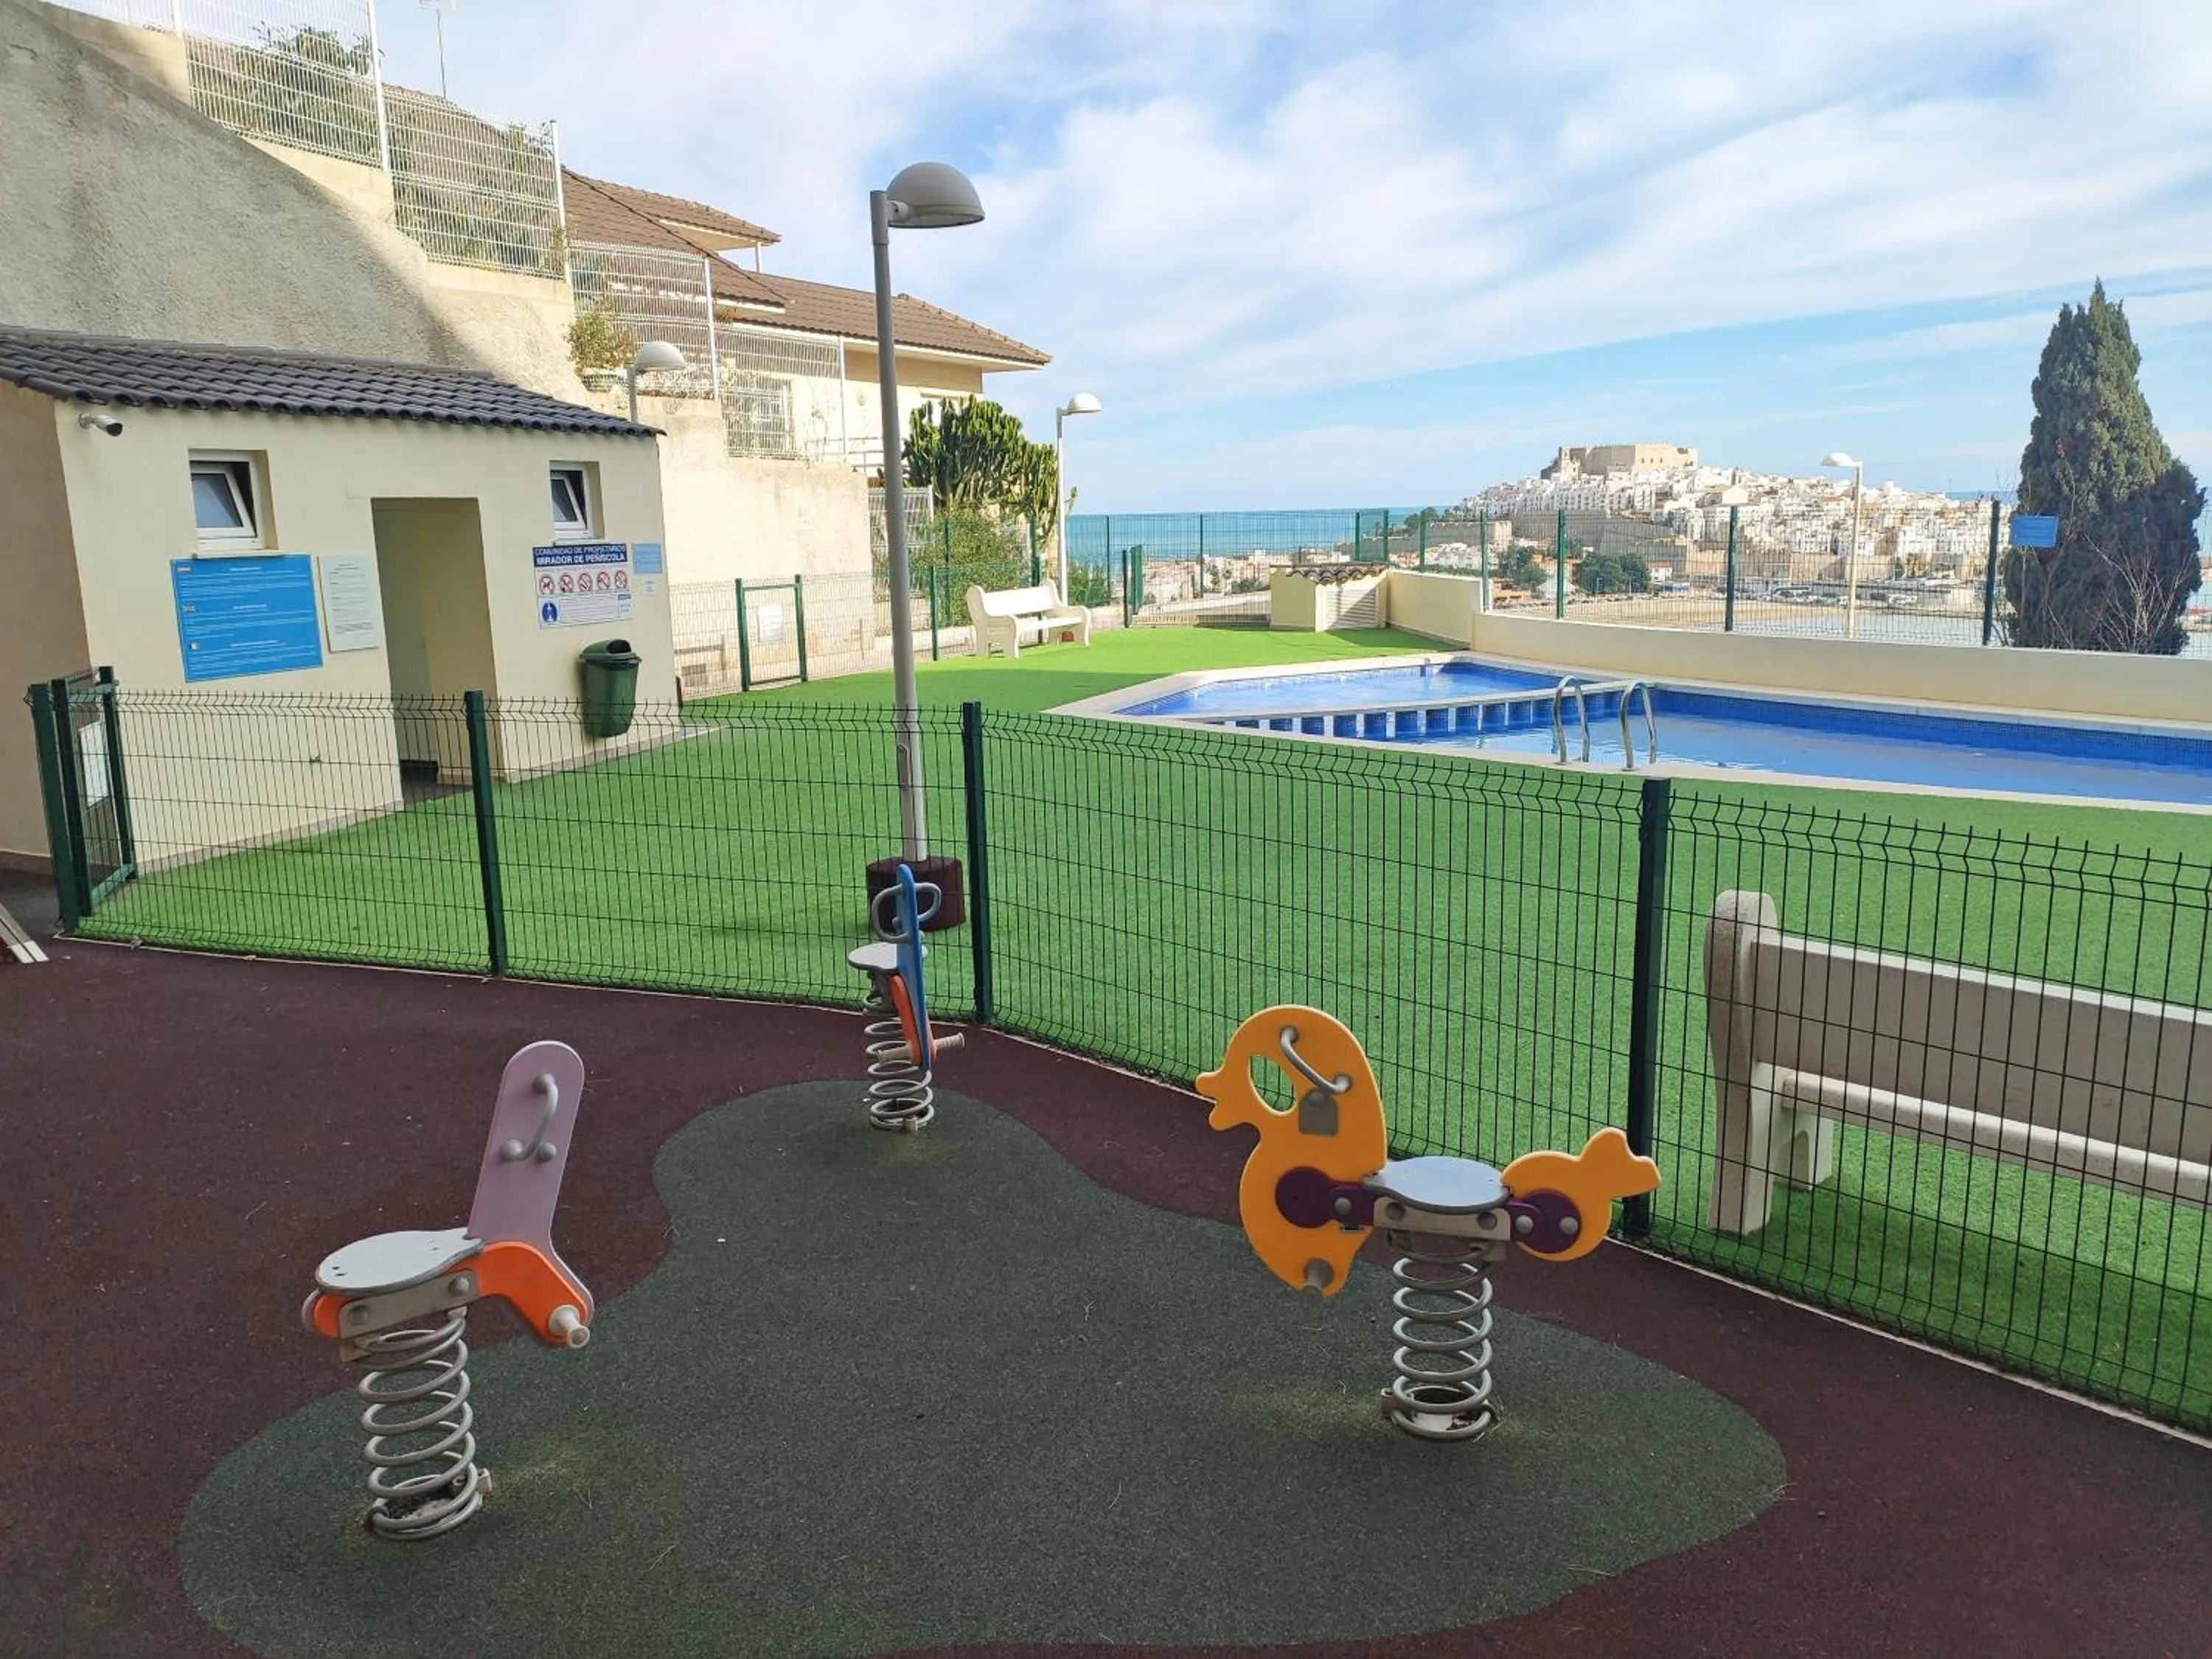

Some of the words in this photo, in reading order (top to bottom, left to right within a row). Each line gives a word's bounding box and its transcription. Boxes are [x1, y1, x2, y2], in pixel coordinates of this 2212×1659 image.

[535, 546, 573, 555] COMUNIDAD
[574, 546, 583, 554] DE
[536, 555, 573, 566] MIRADOR
[574, 554, 584, 563] DE
